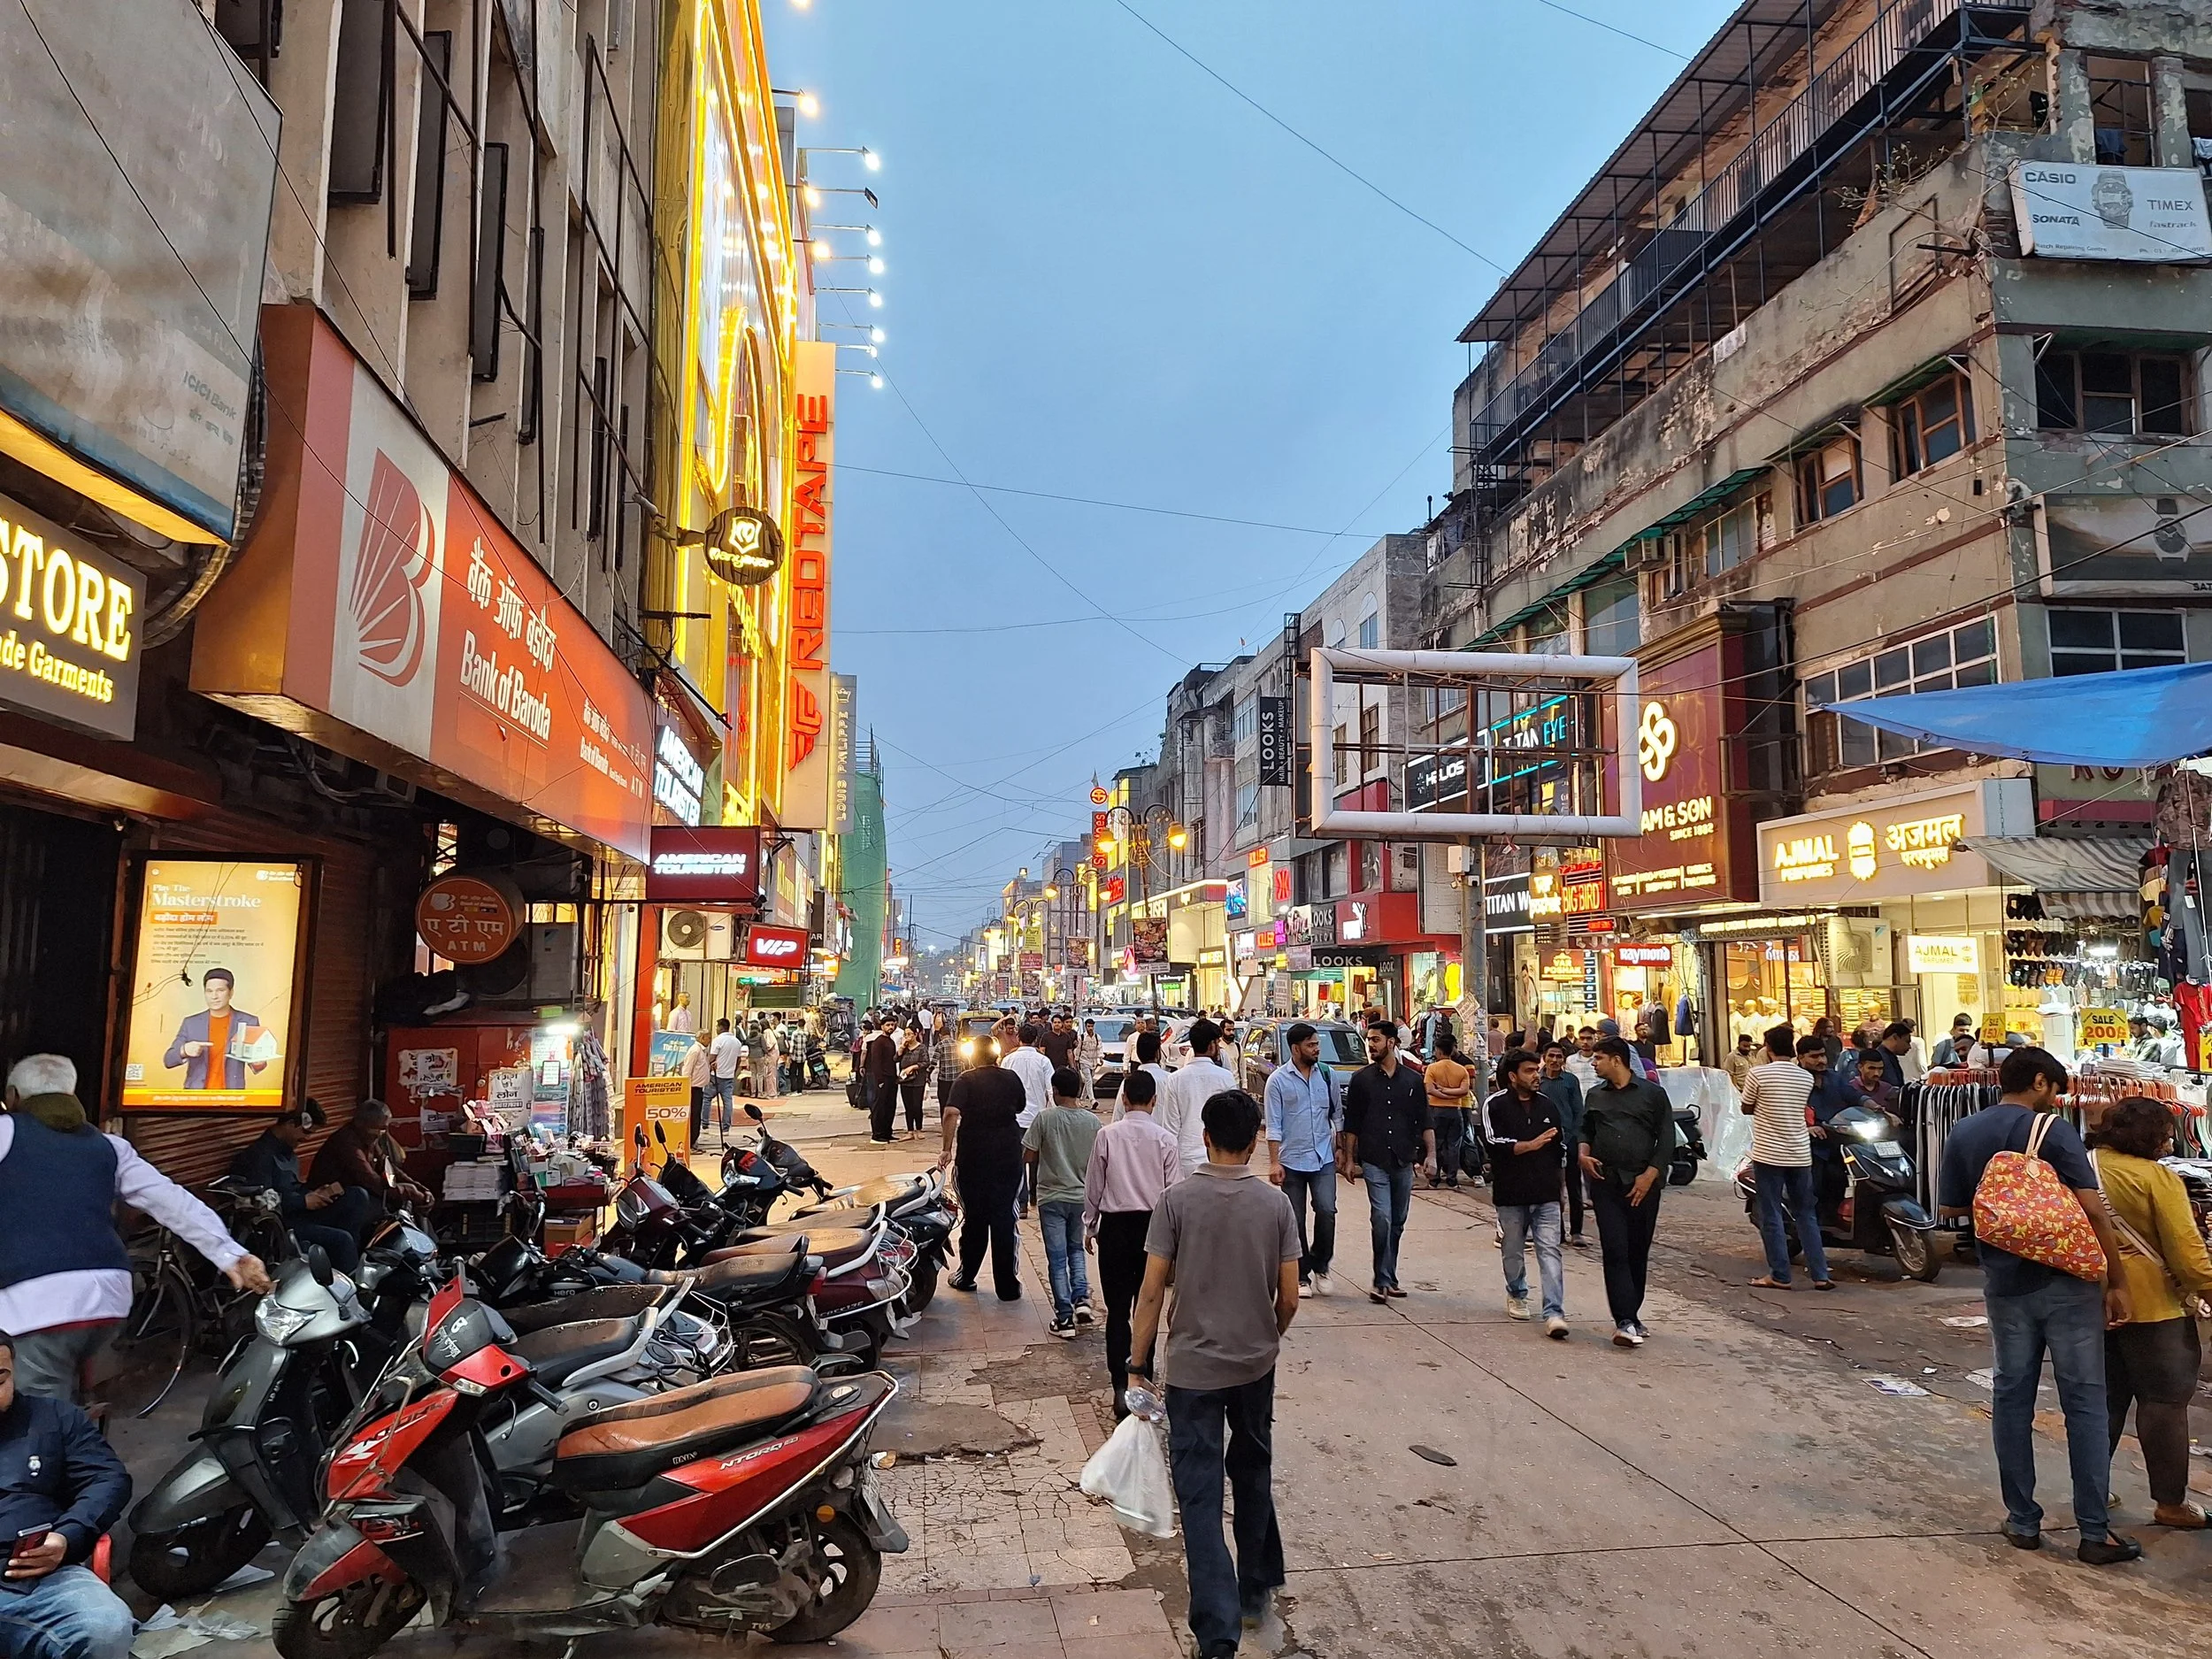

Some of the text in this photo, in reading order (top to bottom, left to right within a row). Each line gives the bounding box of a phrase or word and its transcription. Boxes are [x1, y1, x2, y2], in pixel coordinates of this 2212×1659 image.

[2025, 172, 2077, 185] CASIO
[2147, 199, 2194, 211] TIMEX
[2032, 214, 2081, 227] SONATA
[183, 371, 237, 420] ICICI Bank
[709, 546, 775, 569] Manyavar
[467, 535, 494, 611] बैंक
[28, 640, 114, 703] Garments
[459, 628, 551, 741] Bank of Baroda
[1262, 711, 1275, 771] LOOKS
[1502, 727, 1540, 755] TTAN
[836, 779, 848, 821] LOUIS
[1677, 795, 1713, 826] SON
[1669, 826, 1694, 841] SINCE
[1885, 813, 1966, 851] अजमल
[653, 852, 748, 864] AMERICAN
[1774, 834, 1839, 868] AJMAL
[652, 863, 746, 875] TOURISTER
[151, 892, 262, 908] Masterstroke
[1485, 894, 1516, 915] TITAN
[1562, 887, 1578, 913] BIG
[1578, 882, 1600, 911] BIRD
[425, 914, 504, 940] ए टी एम
[756, 938, 798, 956] VIP
[1618, 946, 1671, 964] Raymond
[1915, 945, 1958, 956] AJMAL
[1312, 956, 1363, 967] LOOKS
[2092, 1015, 2115, 1025] SALE
[647, 1107, 687, 1120] 50%
